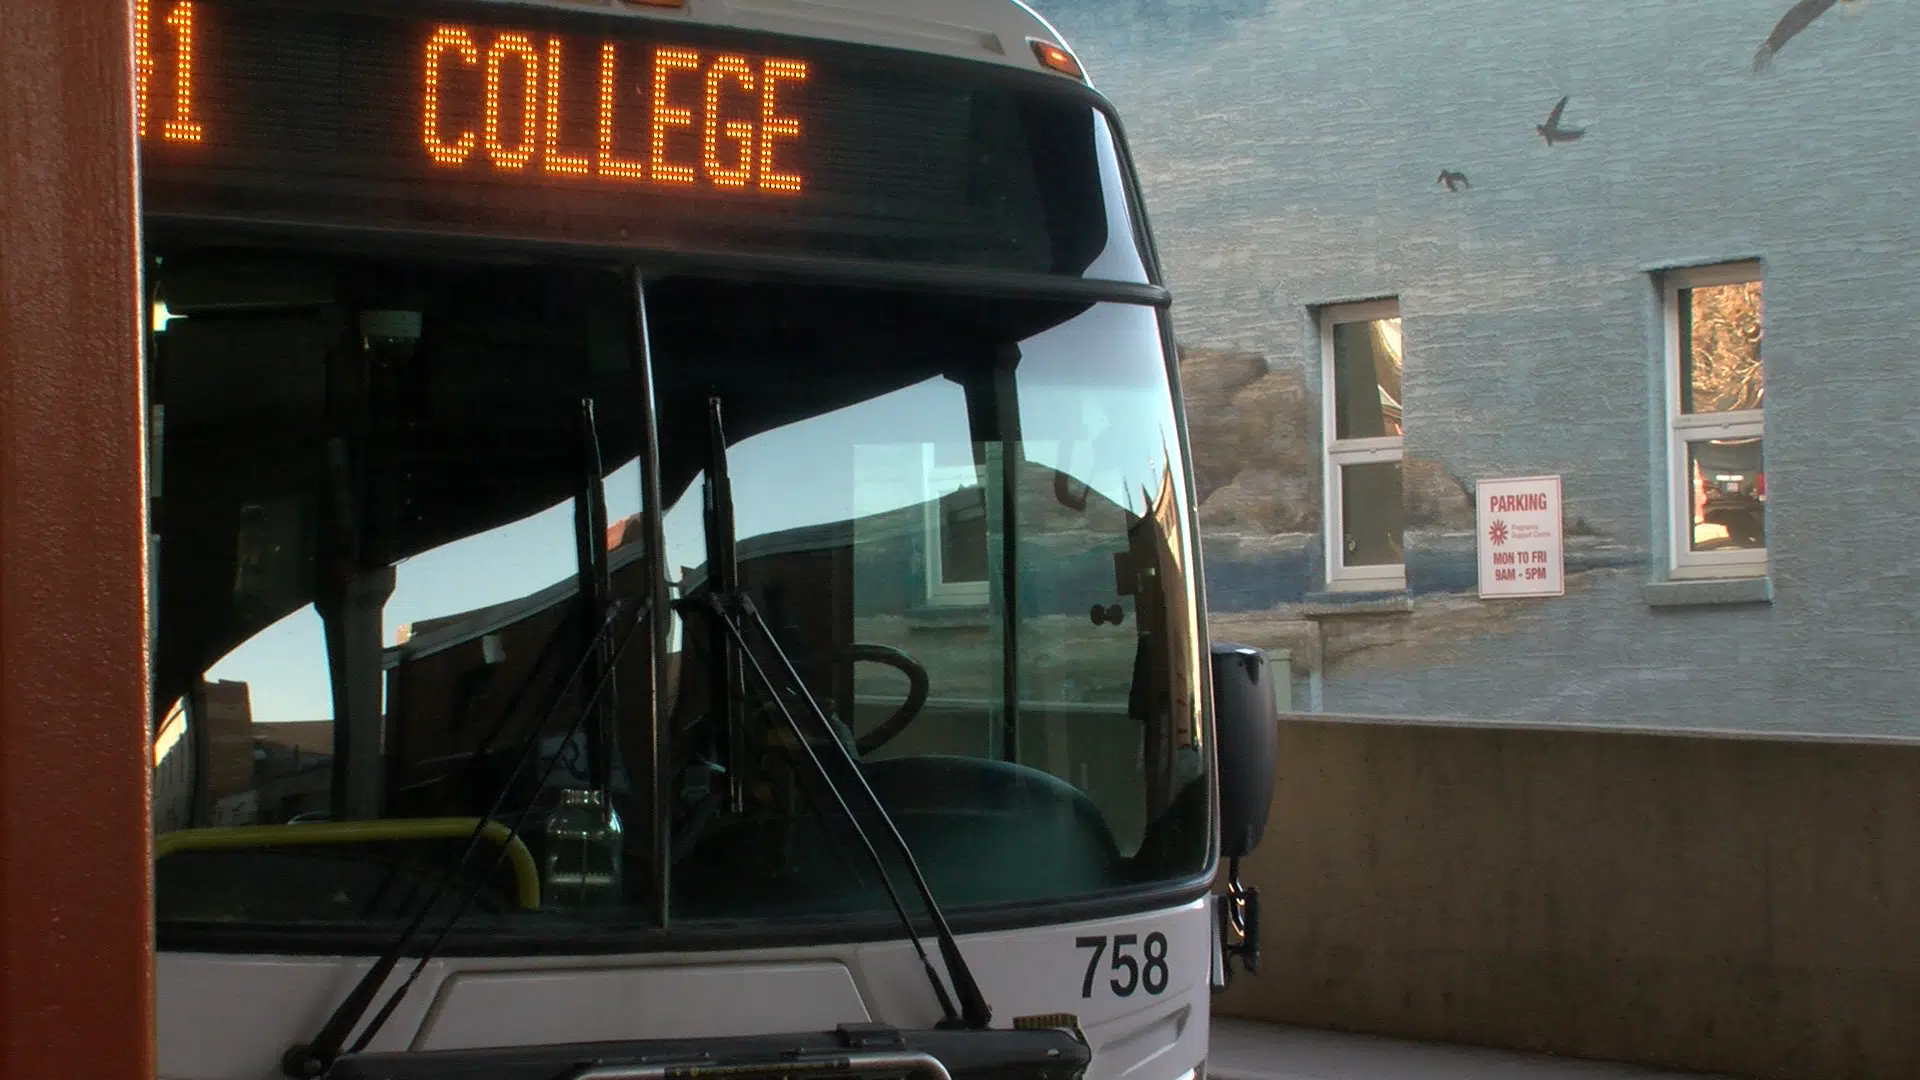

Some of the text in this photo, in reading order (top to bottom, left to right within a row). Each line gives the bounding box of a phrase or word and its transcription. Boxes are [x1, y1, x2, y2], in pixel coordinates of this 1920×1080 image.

[424, 25, 808, 192] COLLEGE
[1490, 493, 1547, 512] PARKING
[1493, 550, 1547, 564] MON TO FRI
[1495, 568, 1516, 580] 9AM
[1525, 567, 1546, 580] 5PM
[1076, 931, 1169, 998] 758
